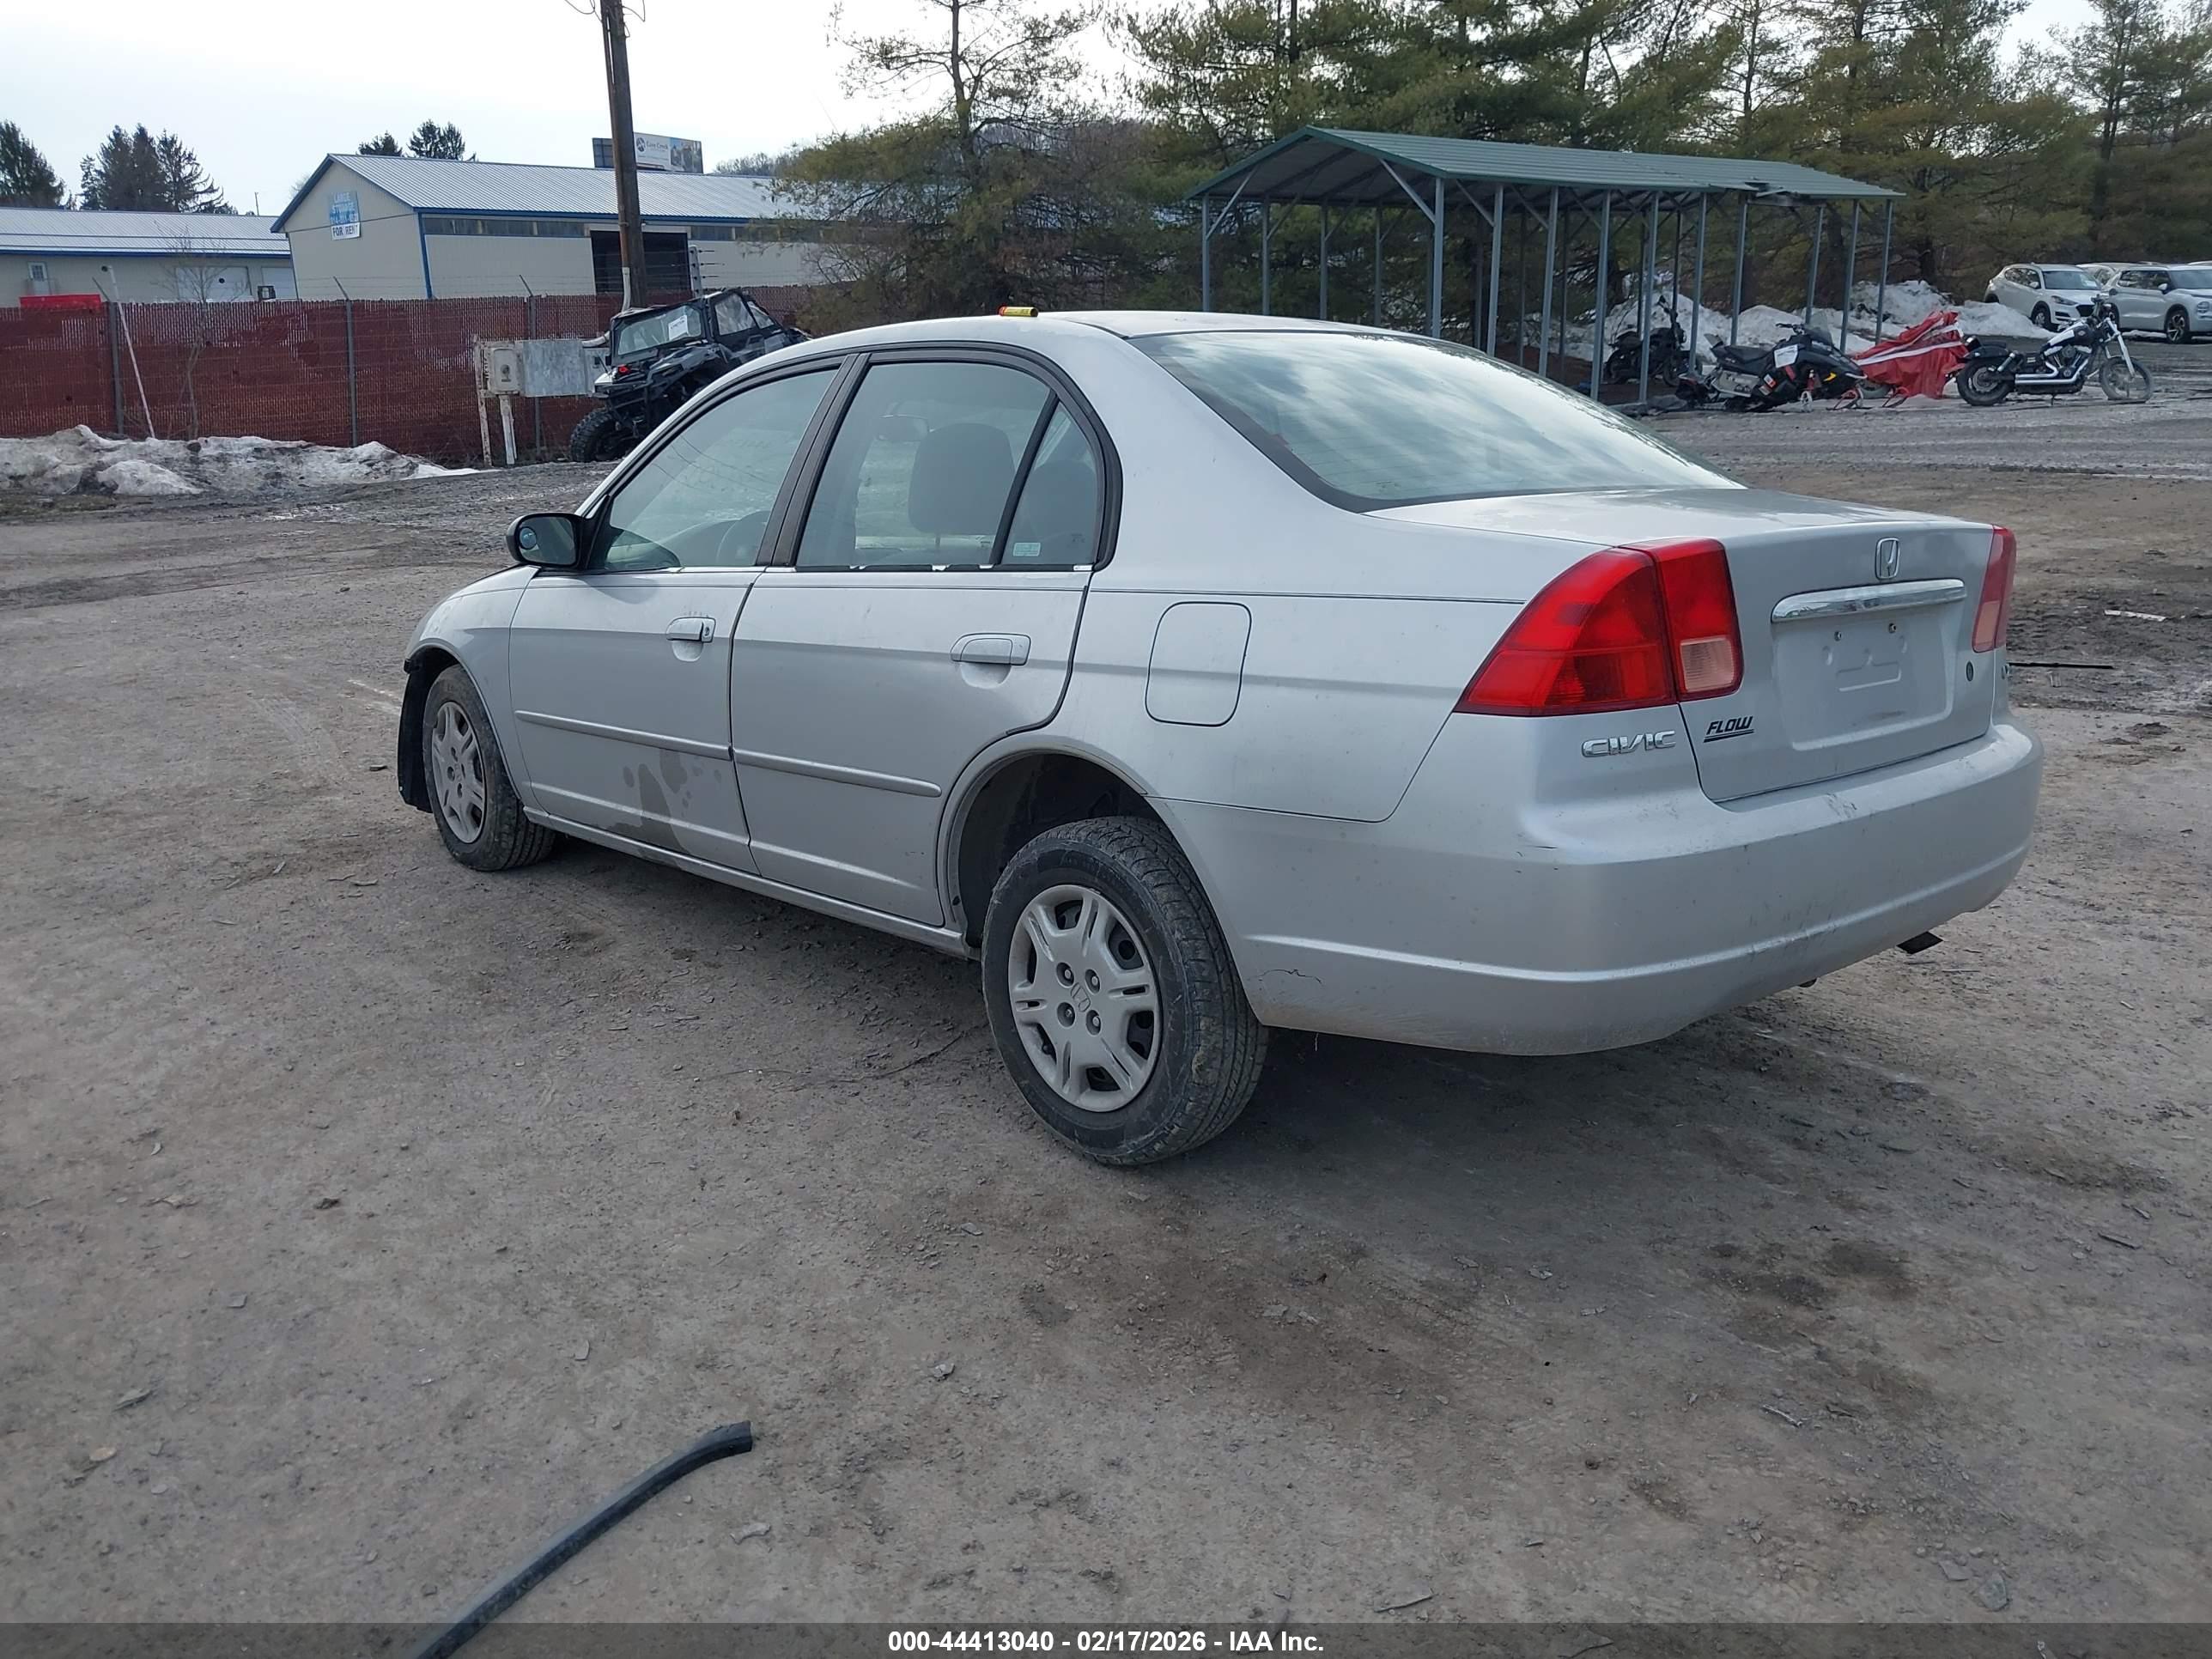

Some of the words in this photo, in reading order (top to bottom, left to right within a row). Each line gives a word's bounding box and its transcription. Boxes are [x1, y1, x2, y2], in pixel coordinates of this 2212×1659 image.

[332, 226, 344, 237] FOR
[345, 224, 358, 235] RENT
[1706, 716, 1753, 735] FLOW
[1582, 730, 1676, 757] CIVIC
